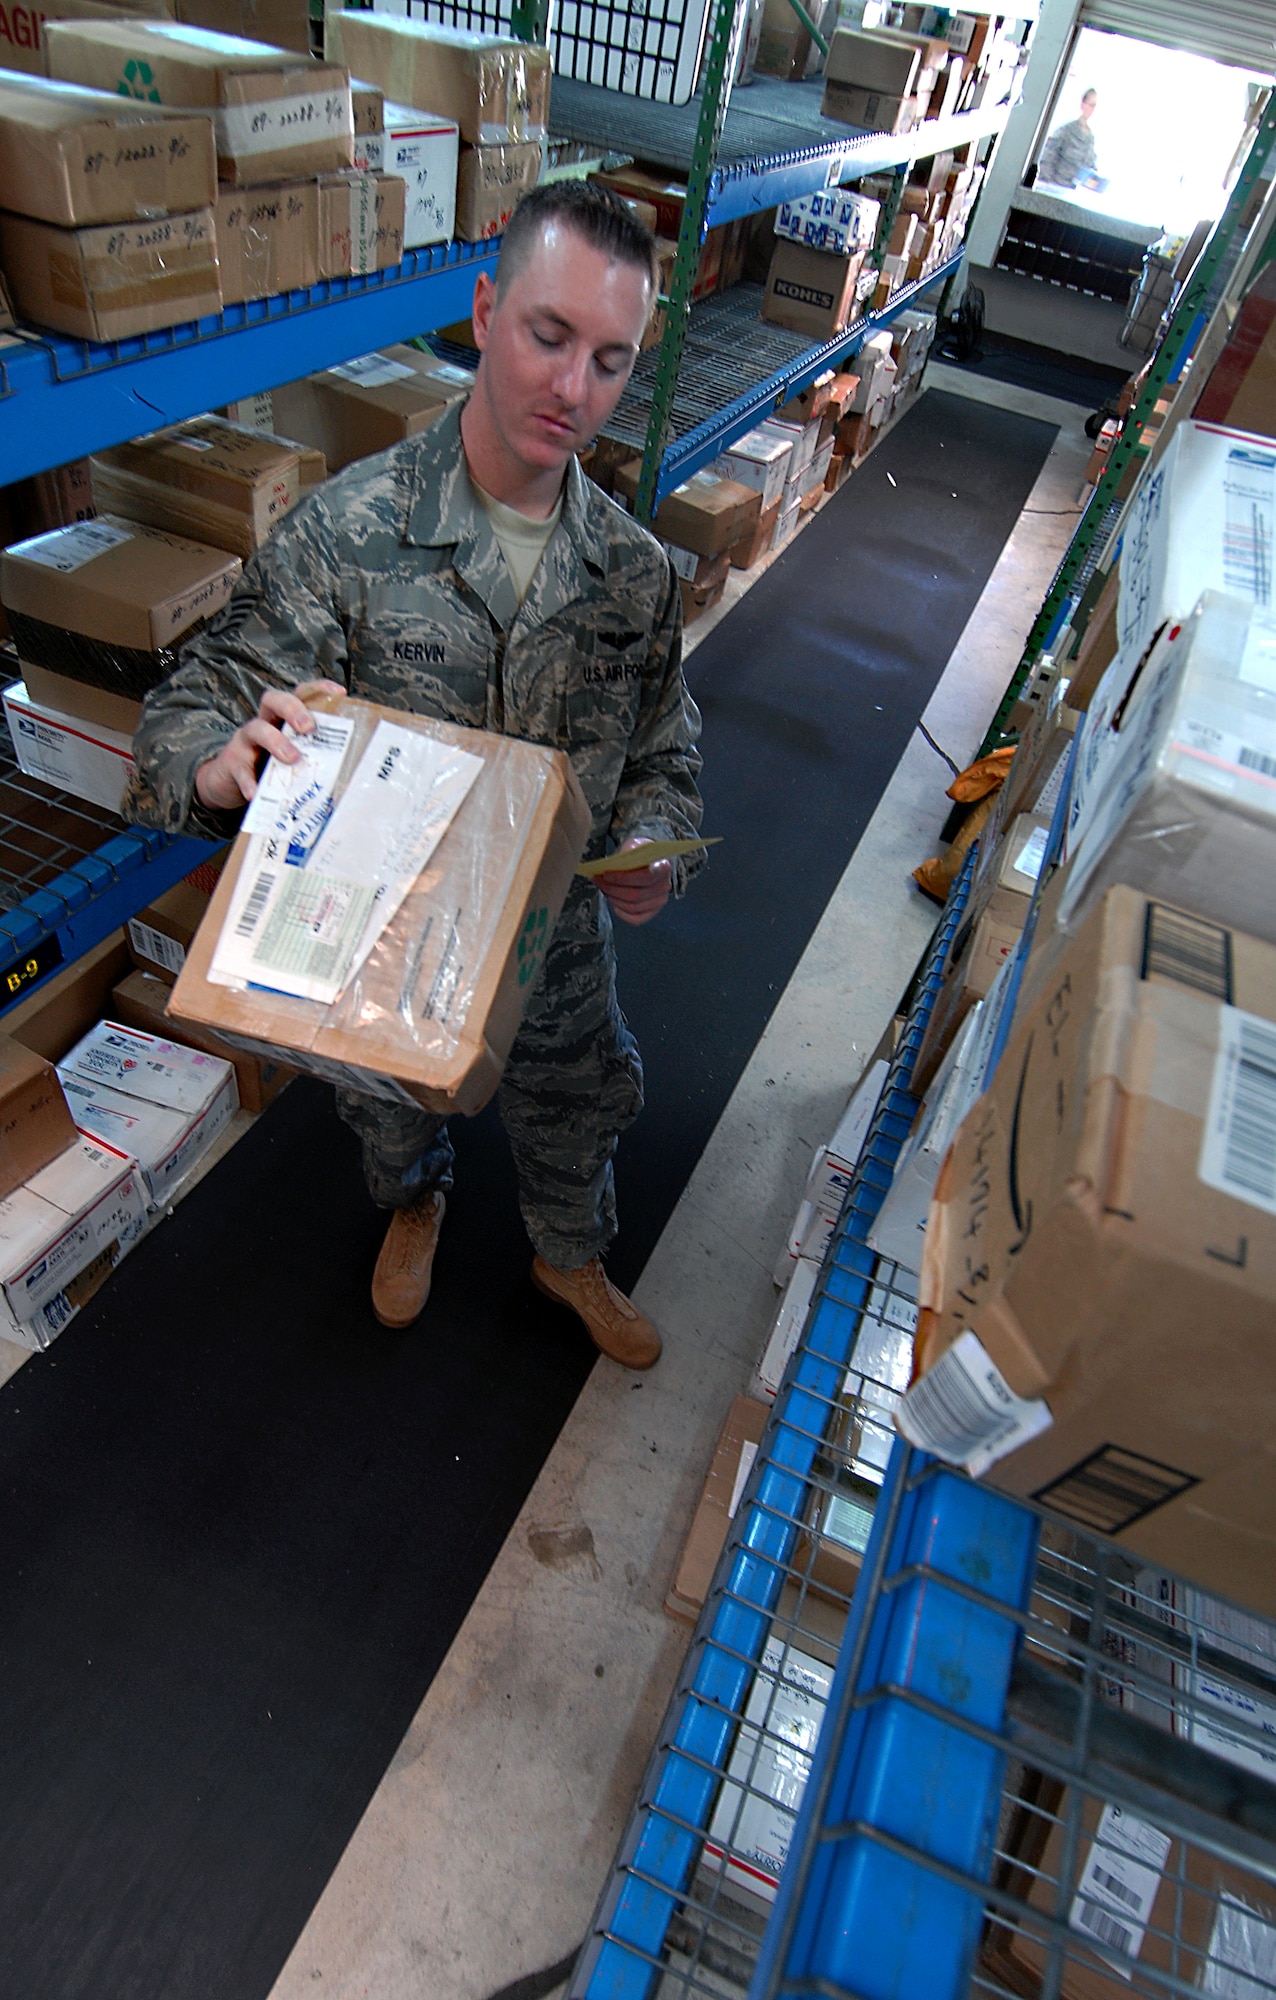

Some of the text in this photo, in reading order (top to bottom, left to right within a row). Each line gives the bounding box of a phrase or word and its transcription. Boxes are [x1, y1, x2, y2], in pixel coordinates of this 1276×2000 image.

[393, 641, 445, 664] KERVIN
[605, 664, 623, 682] AIR
[377, 746, 401, 781] MPS
[7, 959, 38, 992] B-9
